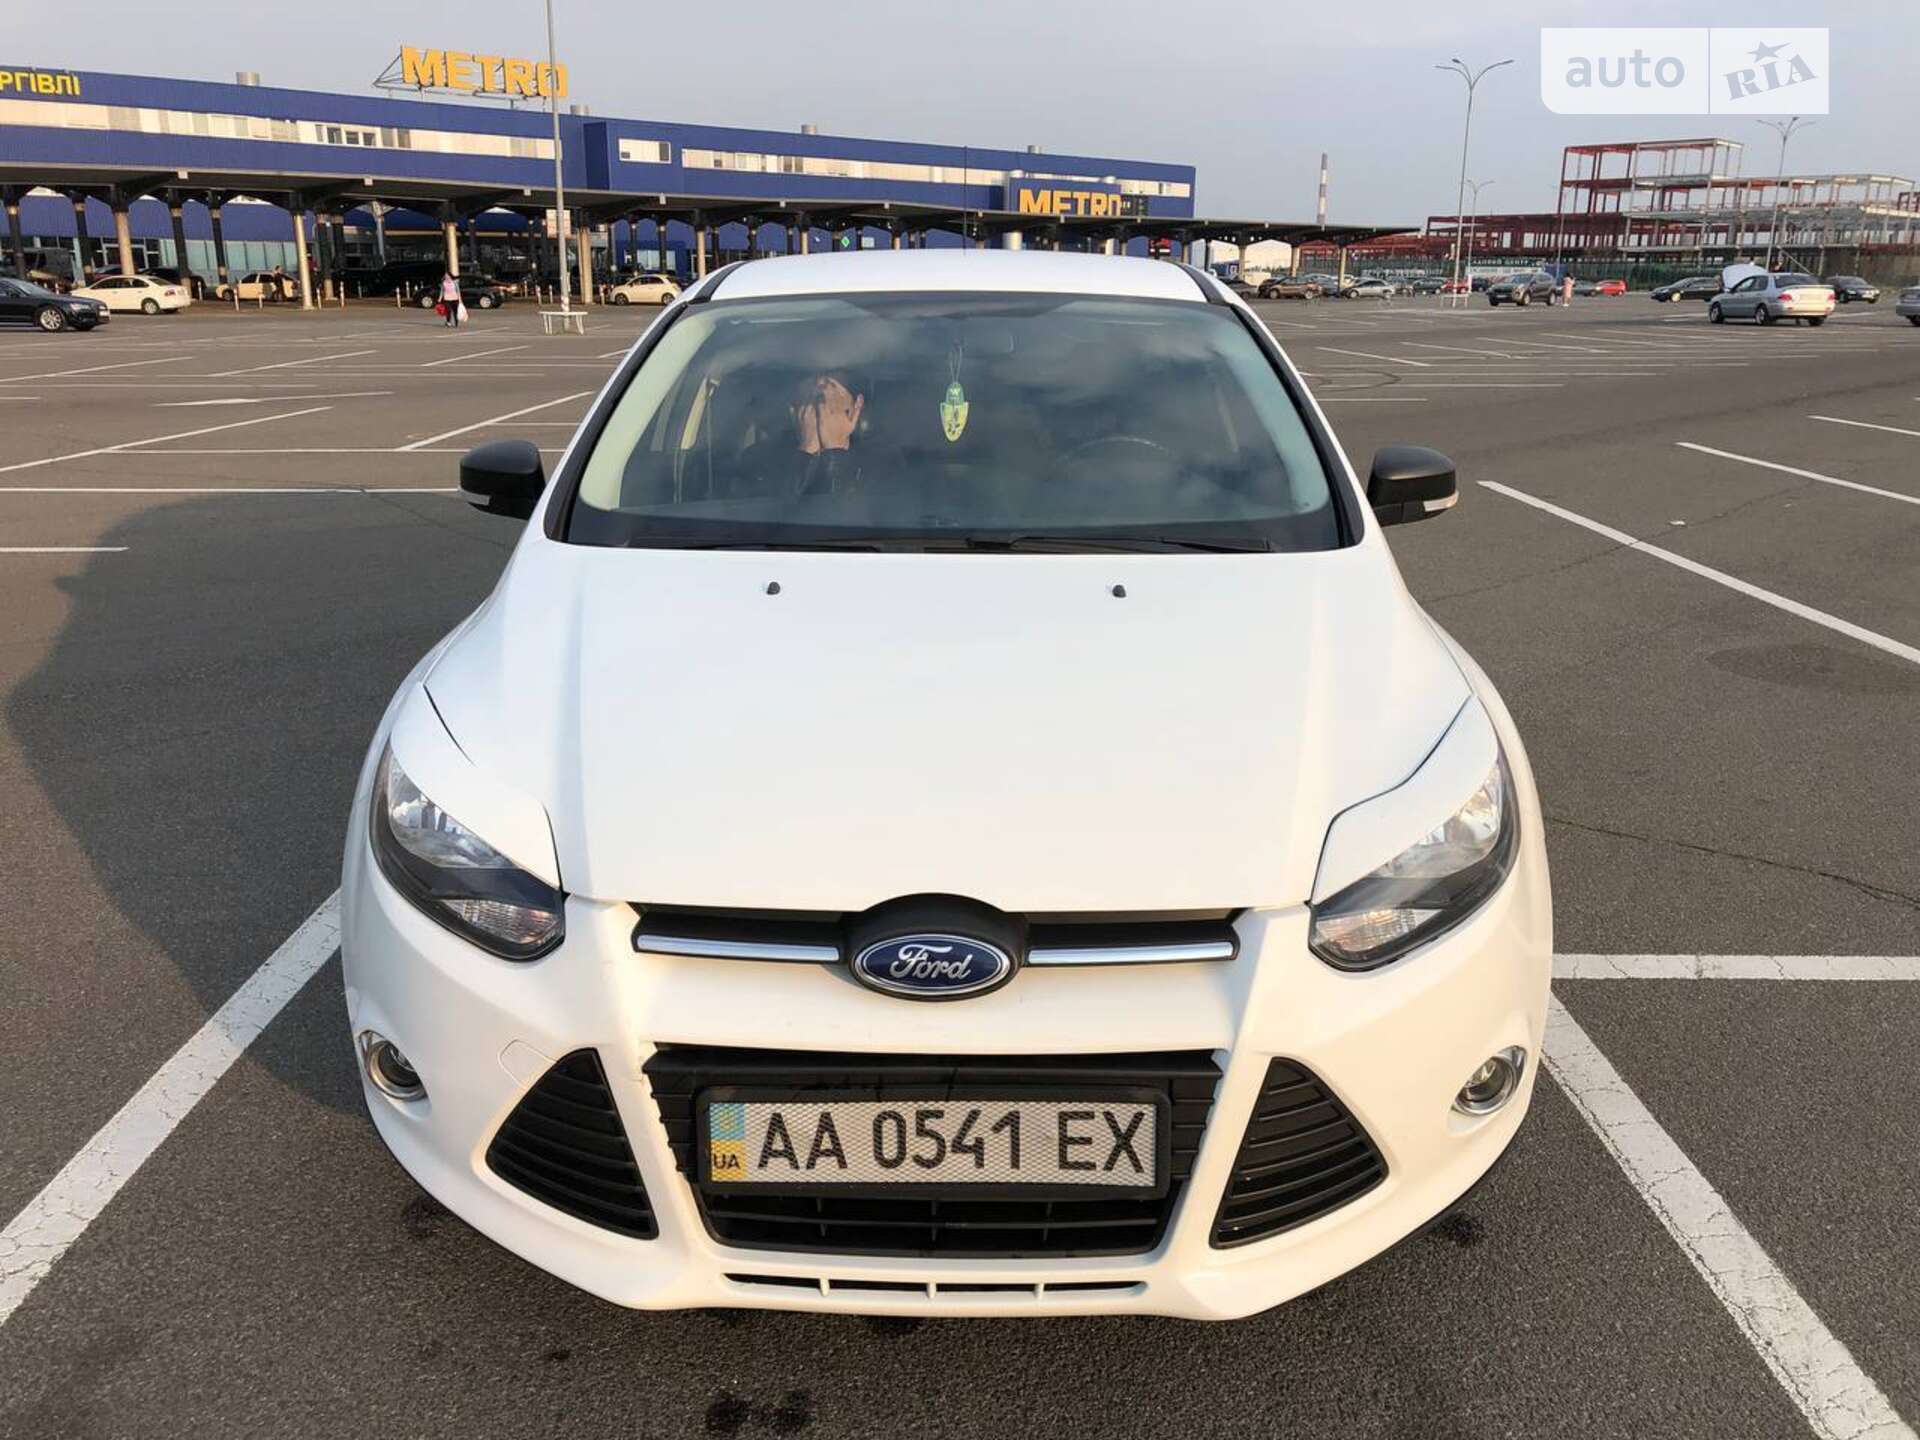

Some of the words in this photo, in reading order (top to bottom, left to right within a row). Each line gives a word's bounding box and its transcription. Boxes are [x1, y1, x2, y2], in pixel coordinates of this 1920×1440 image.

[401, 45, 568, 97] METRO
[1019, 188, 1122, 217] METRO
[889, 943, 973, 979] Ford
[757, 1112, 848, 1170] AA
[872, 1109, 1021, 1170] 0541
[1058, 1110, 1146, 1173] EX
[713, 1153, 741, 1170] UA
